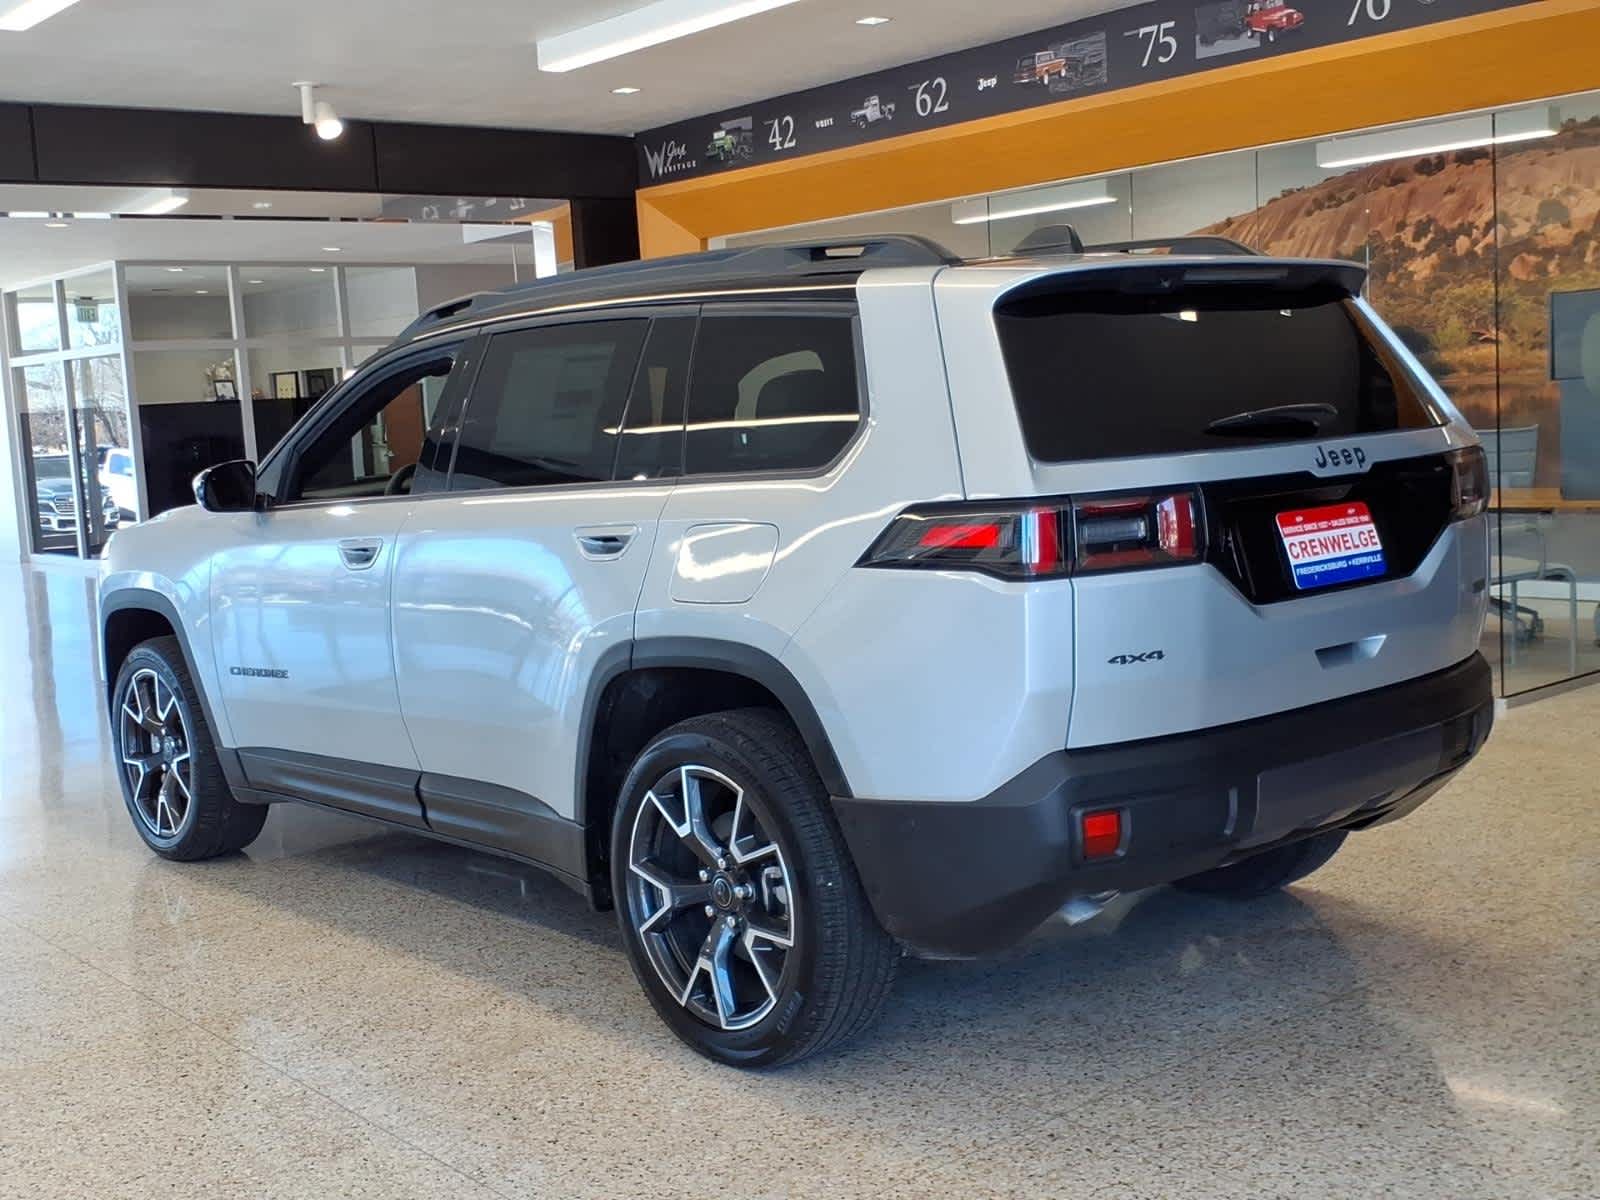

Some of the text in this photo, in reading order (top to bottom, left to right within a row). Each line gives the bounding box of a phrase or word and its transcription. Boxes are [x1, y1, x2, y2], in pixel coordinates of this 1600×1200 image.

[1138, 20, 1178, 68] 75
[915, 76, 949, 117] 62
[768, 115, 797, 151] 42
[1315, 445, 1367, 469] Jeep
[1287, 529, 1379, 560] CRENWELGE
[229, 666, 289, 679] CHEROKEE
